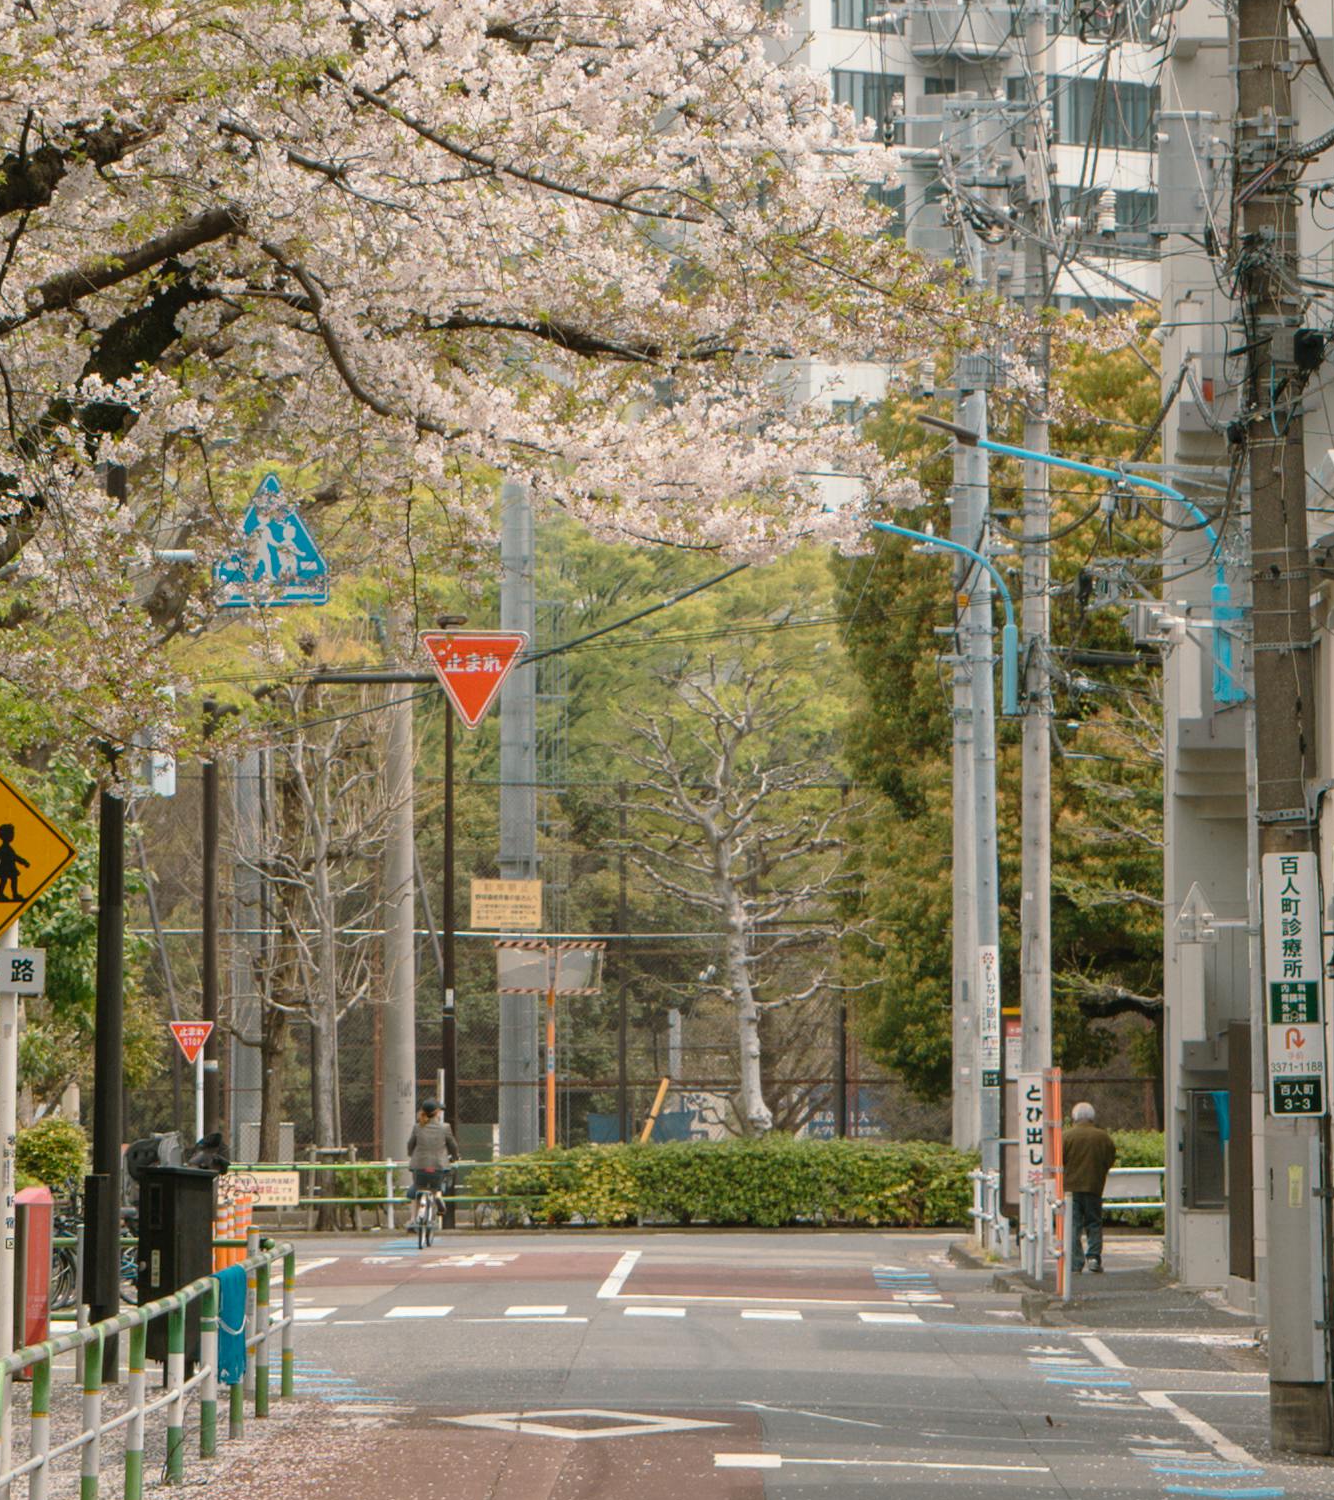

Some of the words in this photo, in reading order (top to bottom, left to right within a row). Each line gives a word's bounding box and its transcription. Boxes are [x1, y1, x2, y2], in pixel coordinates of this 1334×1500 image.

[443, 652, 503, 673] 止まれ
[1279, 856, 1303, 979] 百人町診療所
[182, 1037, 202, 1047] STOP
[1280, 1084, 1314, 1096] 百人町
[1283, 1098, 1311, 1110] 3-3
